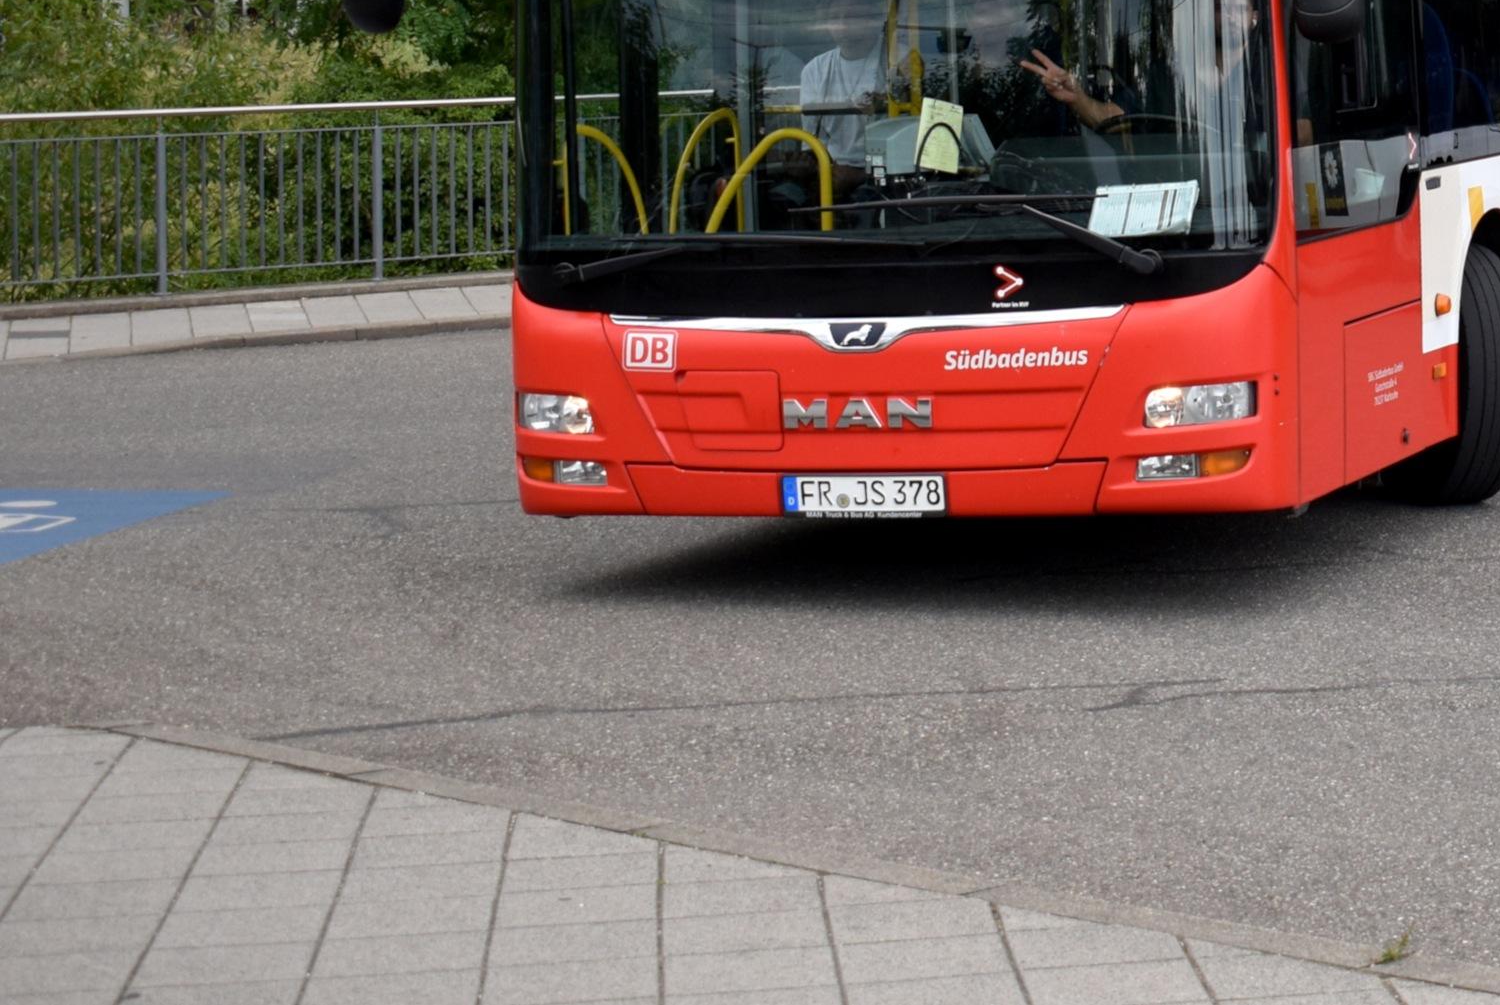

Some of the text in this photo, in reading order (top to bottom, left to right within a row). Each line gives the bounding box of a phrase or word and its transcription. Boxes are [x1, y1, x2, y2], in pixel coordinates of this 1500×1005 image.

[630, 336, 669, 364] DB
[944, 347, 1088, 371] Südbadenbus
[783, 397, 933, 429] MAN
[787, 497, 795, 506] D
[800, 480, 833, 507] FR
[893, 479, 941, 506] 378
